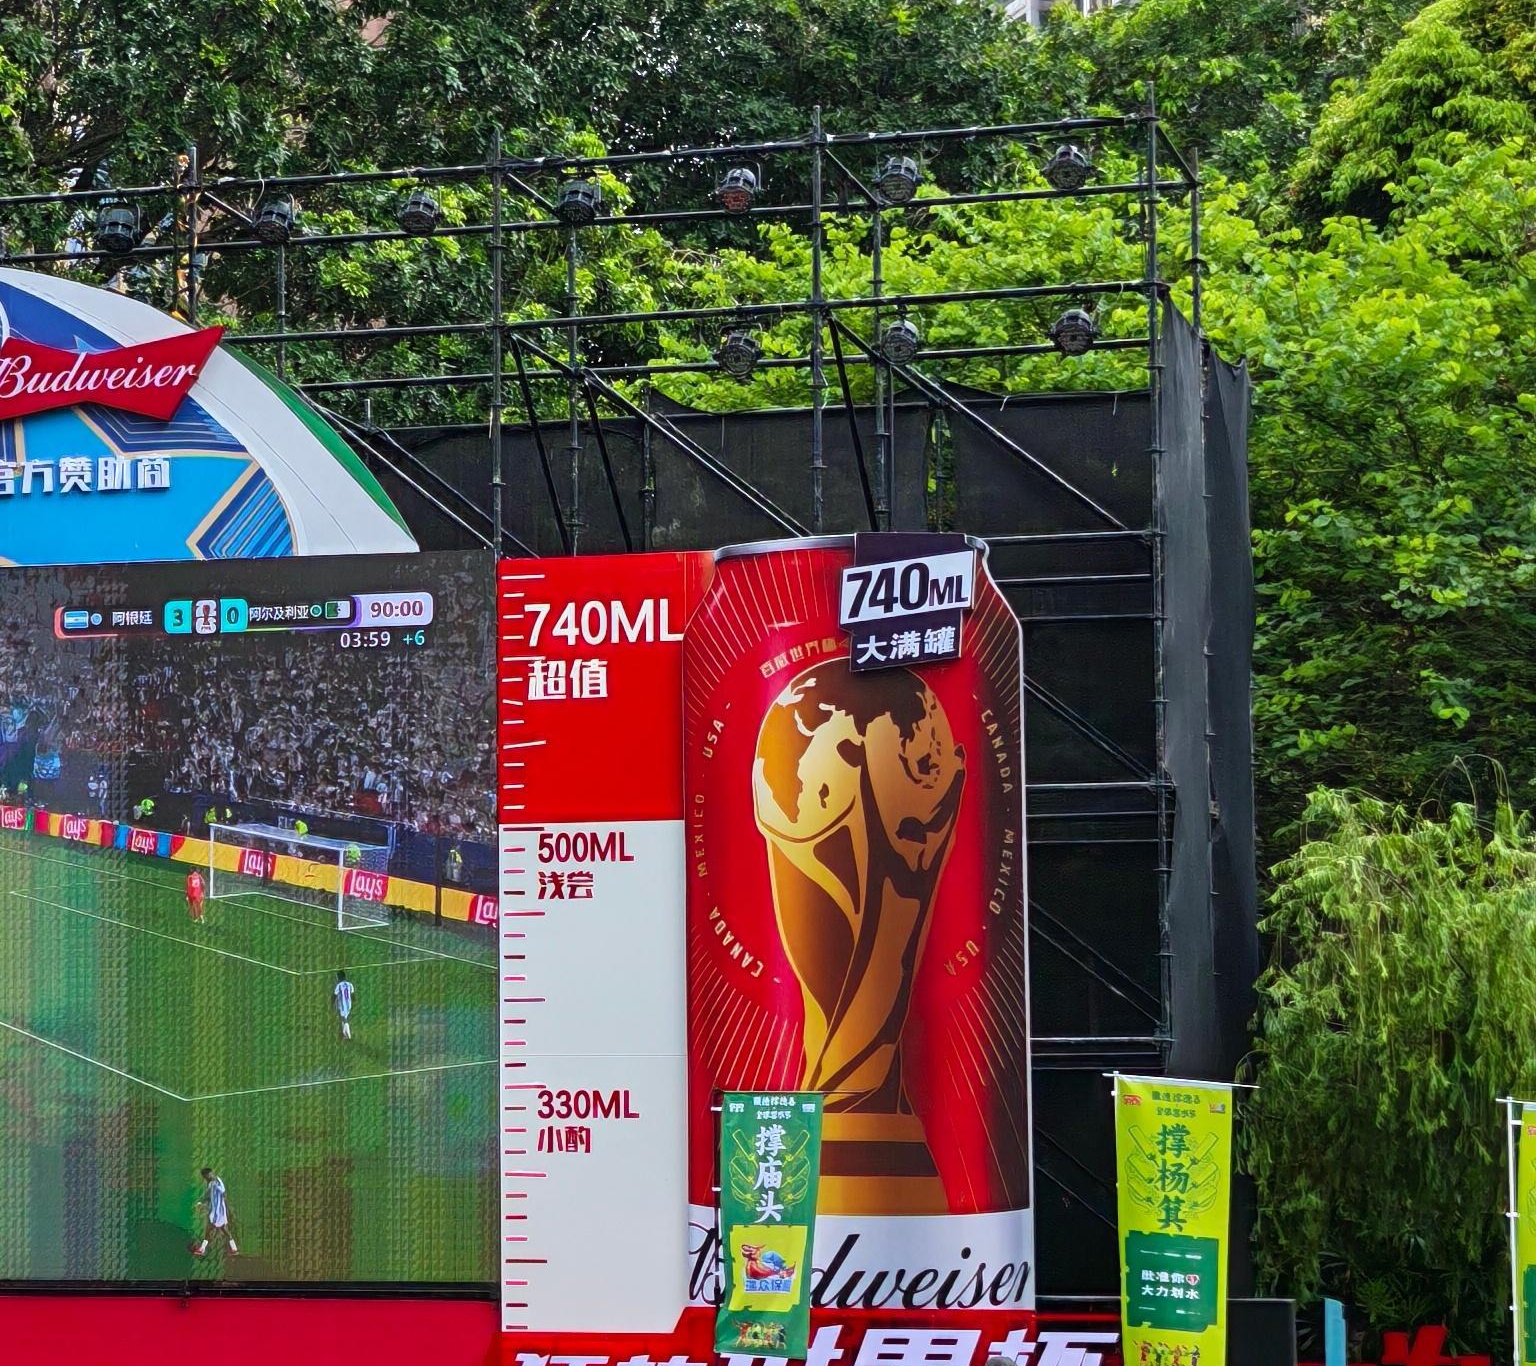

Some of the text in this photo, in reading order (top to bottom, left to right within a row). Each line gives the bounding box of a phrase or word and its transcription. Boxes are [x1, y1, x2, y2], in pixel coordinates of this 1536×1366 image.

[847, 562, 969, 619] 740ML
[112, 610, 153, 626] 阿根廷
[172, 608, 184, 627] 3
[226, 606, 240, 624] 0
[249, 604, 309, 621] 阿尔及利亚
[370, 600, 424, 619] 90:00
[524, 598, 684, 648] 740ML
[340, 629, 425, 648] 03:59 +6
[856, 625, 957, 664] 大满罐
[527, 659, 609, 701] 超值
[702, 718, 725, 759] USA
[981, 709, 1014, 794] CANADA
[244, 849, 272, 877] Lay
[538, 832, 634, 864] 500ML
[351, 869, 383, 900] Lay's
[537, 871, 594, 900] 浅尝
[989, 827, 1015, 916] MEXICO
[709, 906, 764, 978] CANADA
[537, 1089, 639, 1120] 330ML
[537, 1126, 591, 1154] 小酌
[752, 1124, 787, 1223] 撑庙头
[1156, 1123, 1191, 1232] 撑杨箕
